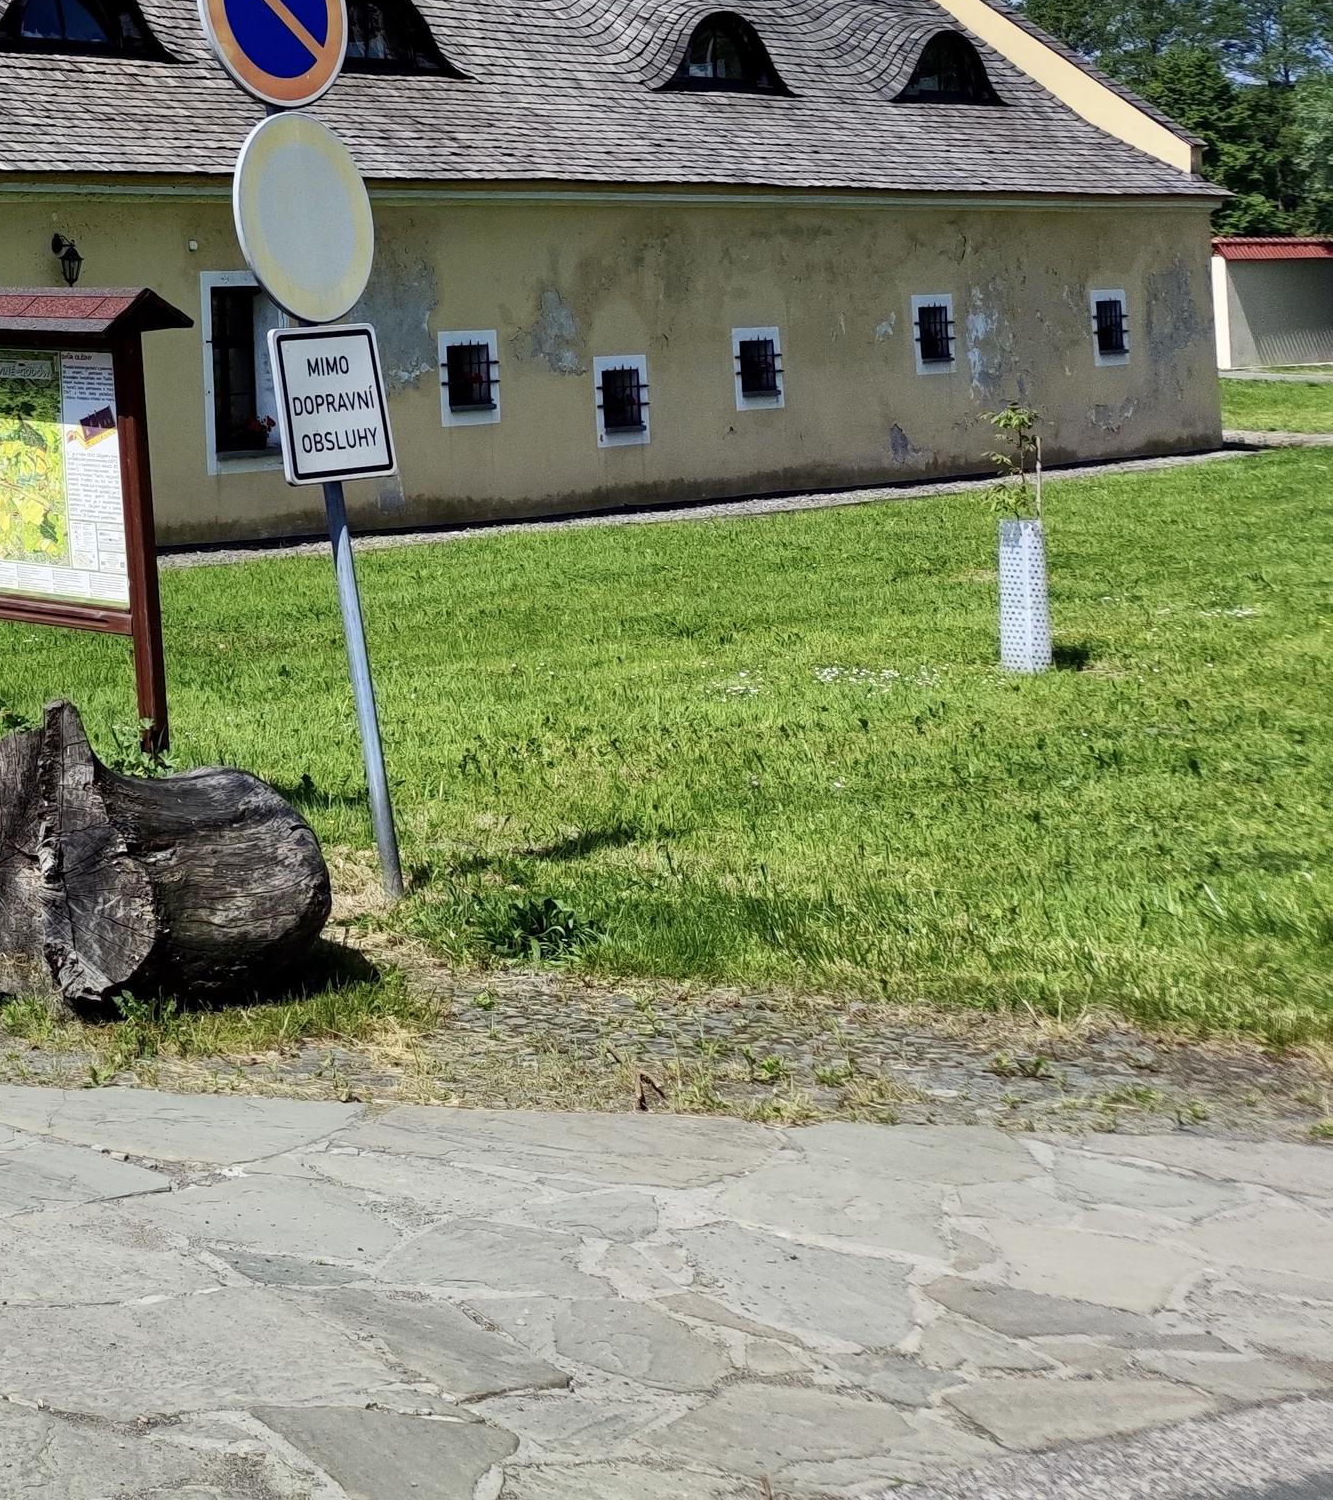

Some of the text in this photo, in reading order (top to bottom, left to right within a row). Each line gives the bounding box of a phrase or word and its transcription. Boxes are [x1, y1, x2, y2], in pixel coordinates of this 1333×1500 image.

[306, 355, 350, 377] MIMO
[292, 385, 375, 417] DOPRAVNÍ
[301, 427, 377, 454] OBSLUHY
